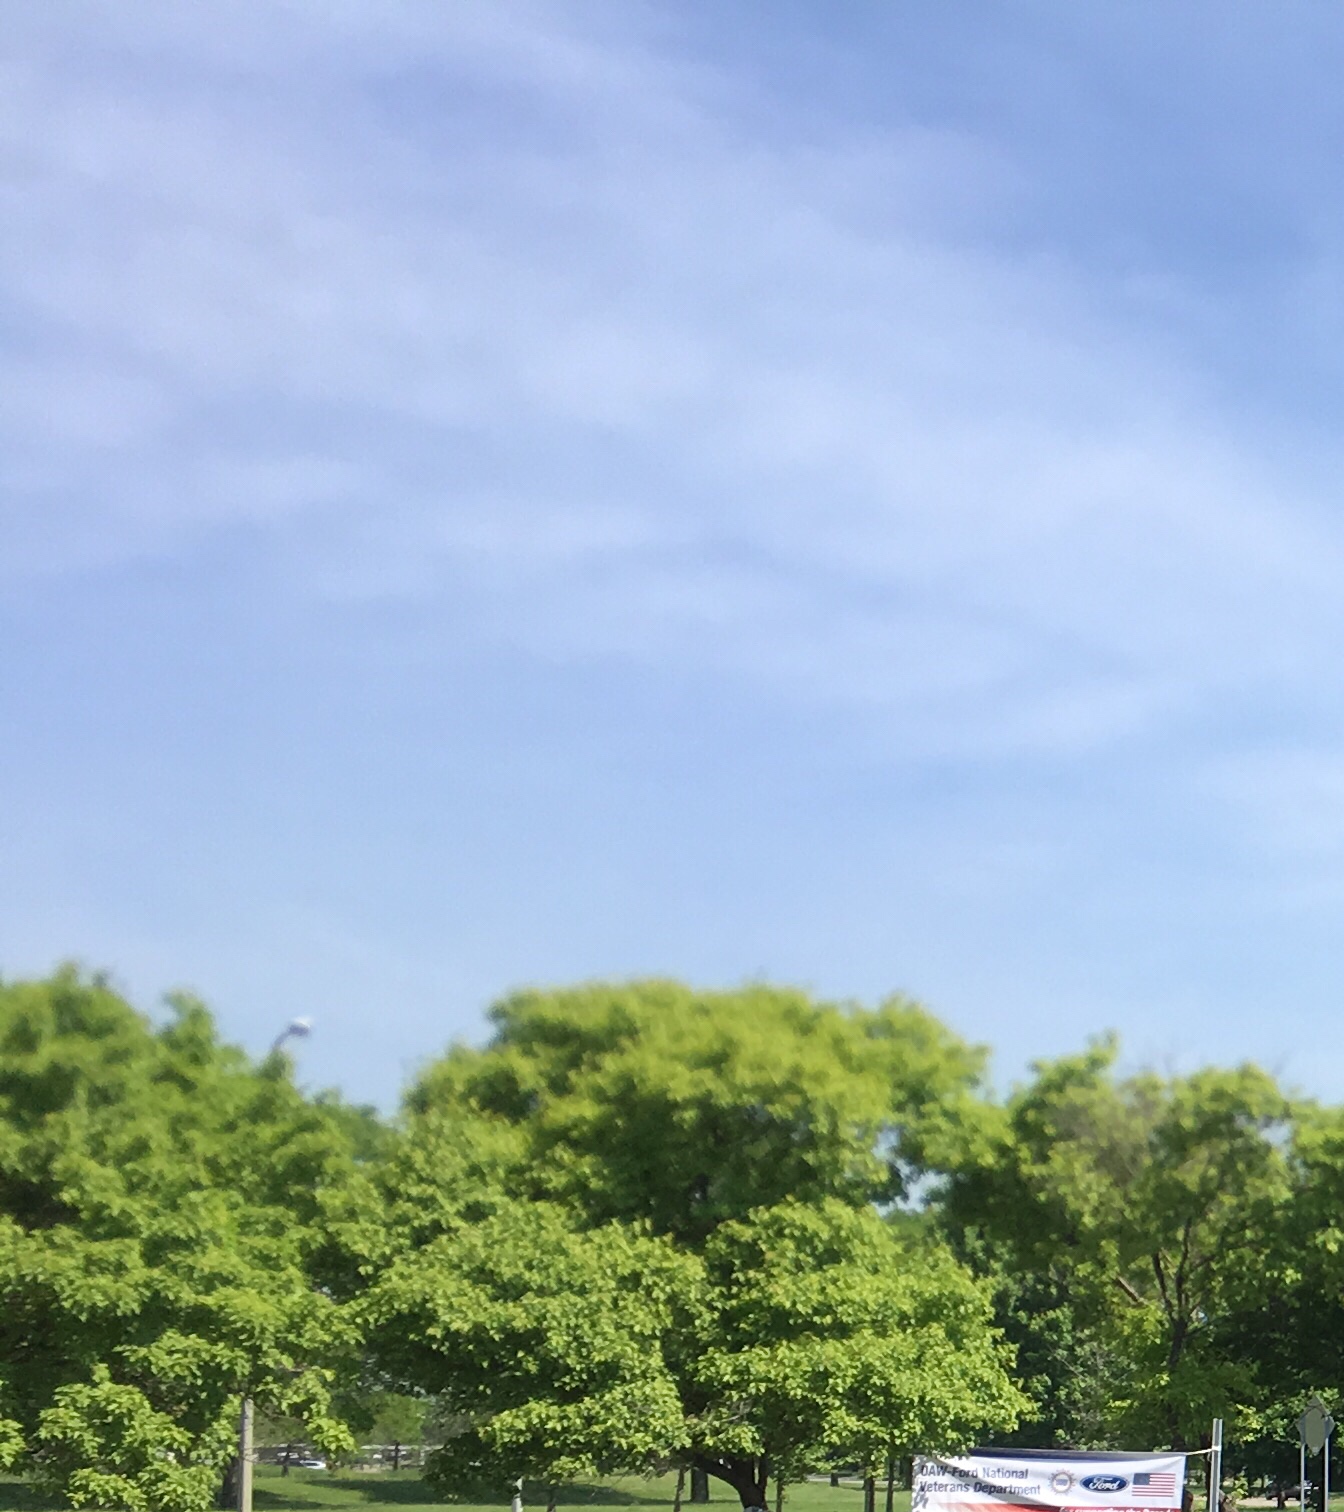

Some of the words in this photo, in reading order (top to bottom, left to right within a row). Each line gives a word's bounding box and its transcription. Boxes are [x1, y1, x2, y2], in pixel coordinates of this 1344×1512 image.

[982, 1467, 1028, 1479] National
[920, 1481, 969, 1492] Veterans
[974, 1482, 1040, 1495] Department
[1088, 1477, 1121, 1490] Ford
